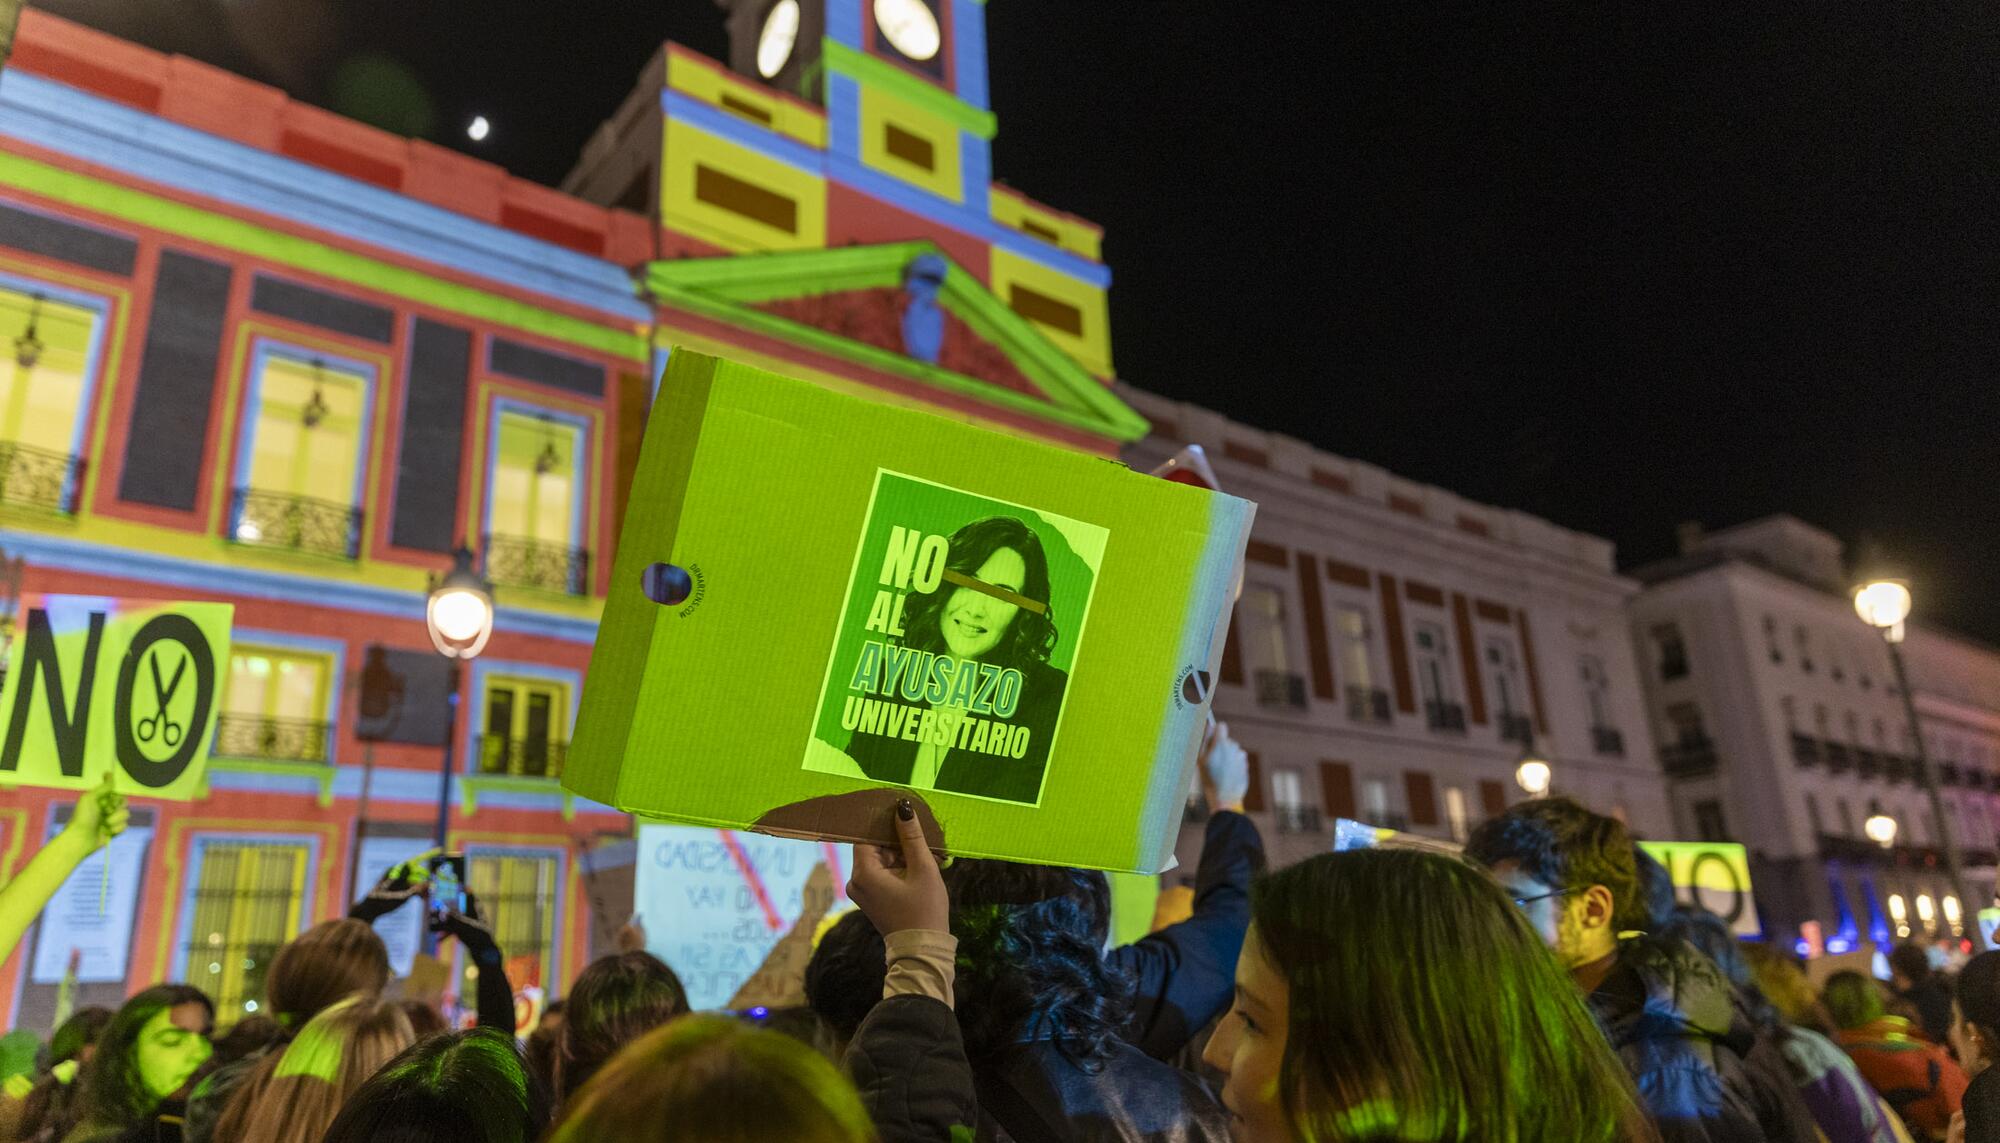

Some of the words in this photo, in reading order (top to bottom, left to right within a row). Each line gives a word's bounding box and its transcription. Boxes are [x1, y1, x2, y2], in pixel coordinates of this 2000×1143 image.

[879, 525, 950, 594] NO
[865, 590, 906, 637] AL
[0, 608, 216, 788] NO
[849, 640, 1023, 719] AYUSAZO
[841, 695, 1031, 760] UNIVERSITARIO
